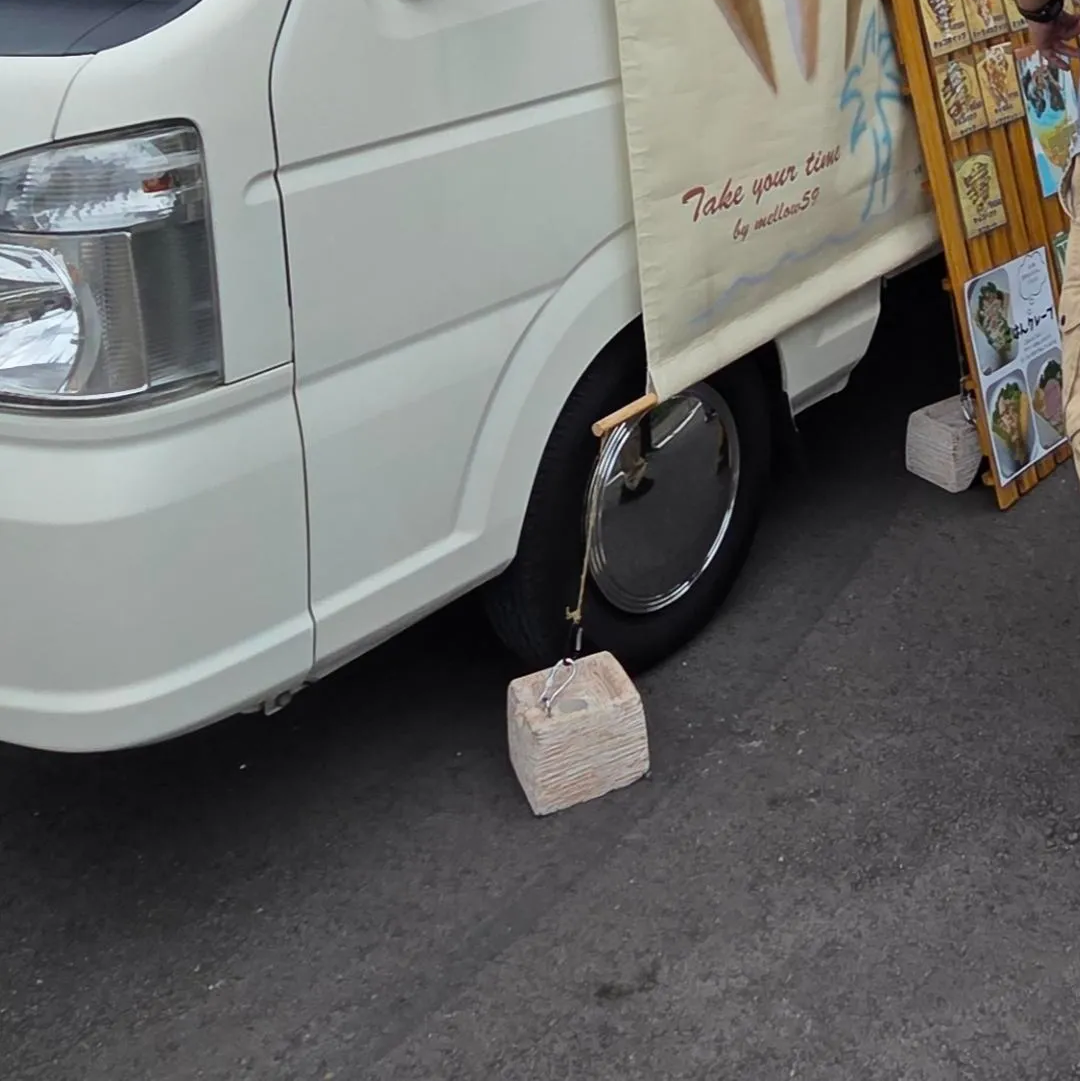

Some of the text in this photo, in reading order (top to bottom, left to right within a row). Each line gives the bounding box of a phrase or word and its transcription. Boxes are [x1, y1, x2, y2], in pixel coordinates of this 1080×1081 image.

[682, 178, 745, 222] Take
[751, 165, 798, 204] your
[733, 186, 820, 241] by mellow59
